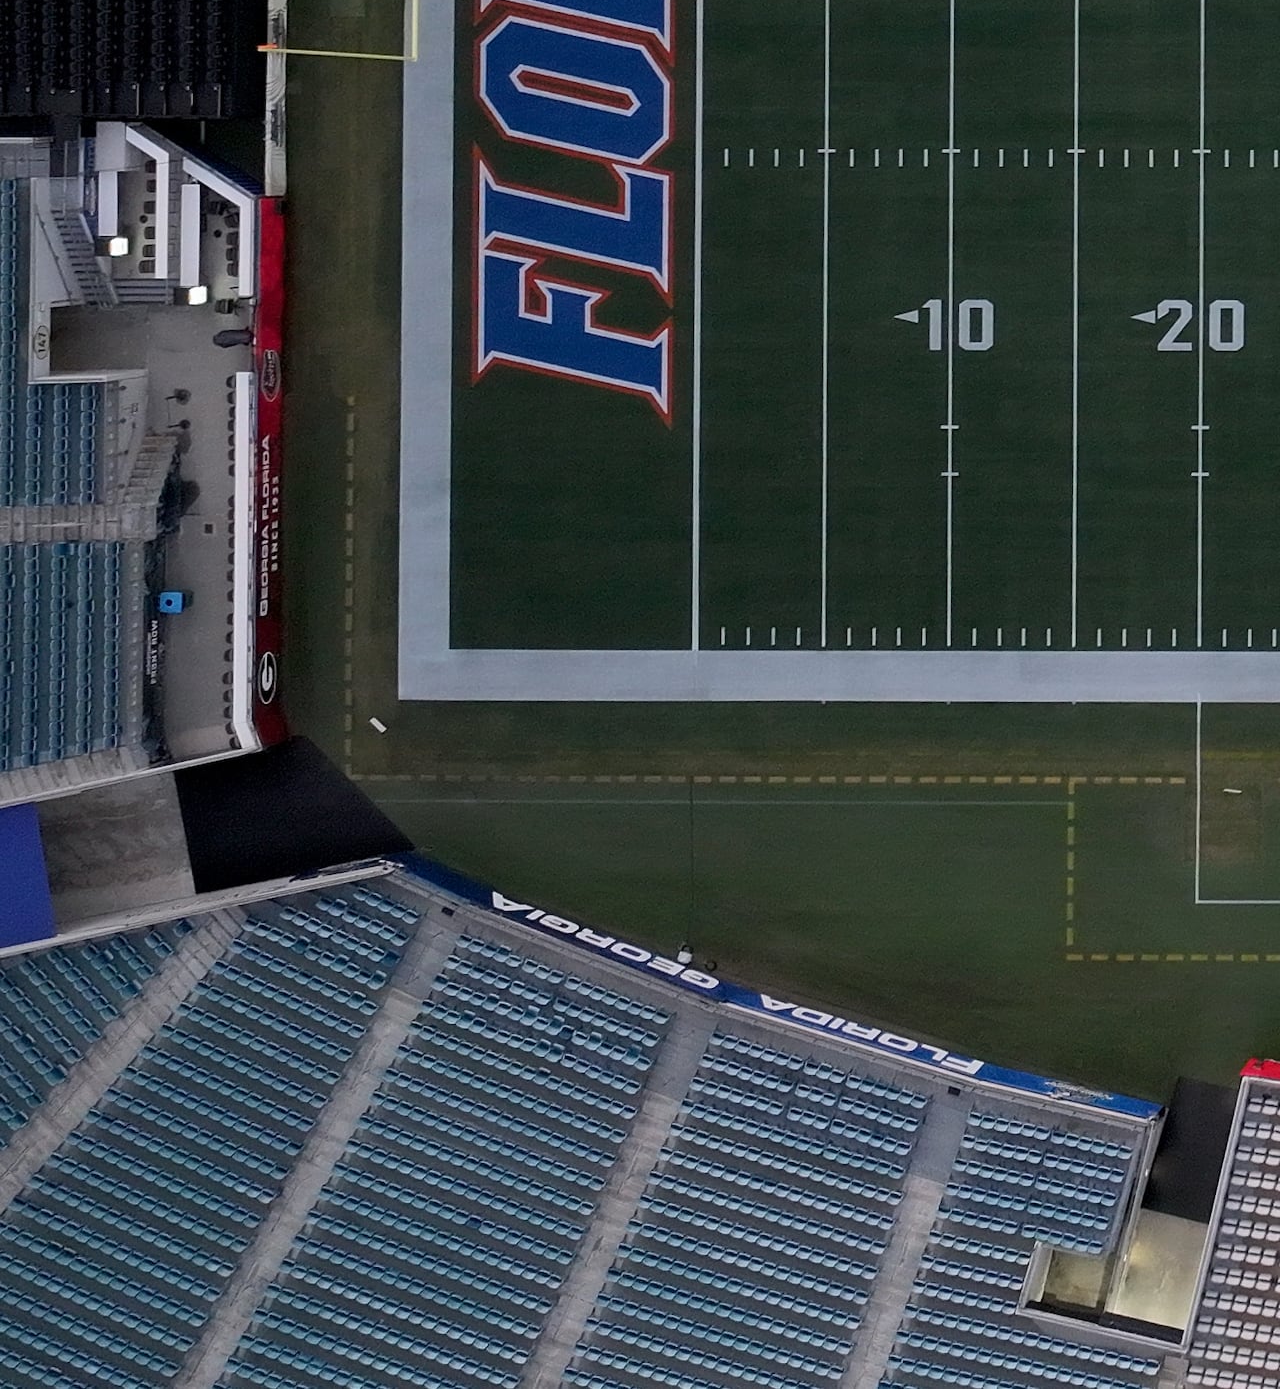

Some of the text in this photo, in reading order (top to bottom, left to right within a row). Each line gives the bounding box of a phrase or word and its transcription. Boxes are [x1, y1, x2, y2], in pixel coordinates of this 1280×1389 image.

[922, 299, 994, 351] 10
[1158, 299, 1245, 352] 20
[260, 434, 271, 617] GEORGIA FLORIDA
[271, 520, 279, 572] SINCE
[492, 891, 720, 990] GEORGIA
[760, 993, 985, 1076] FLORIDA
